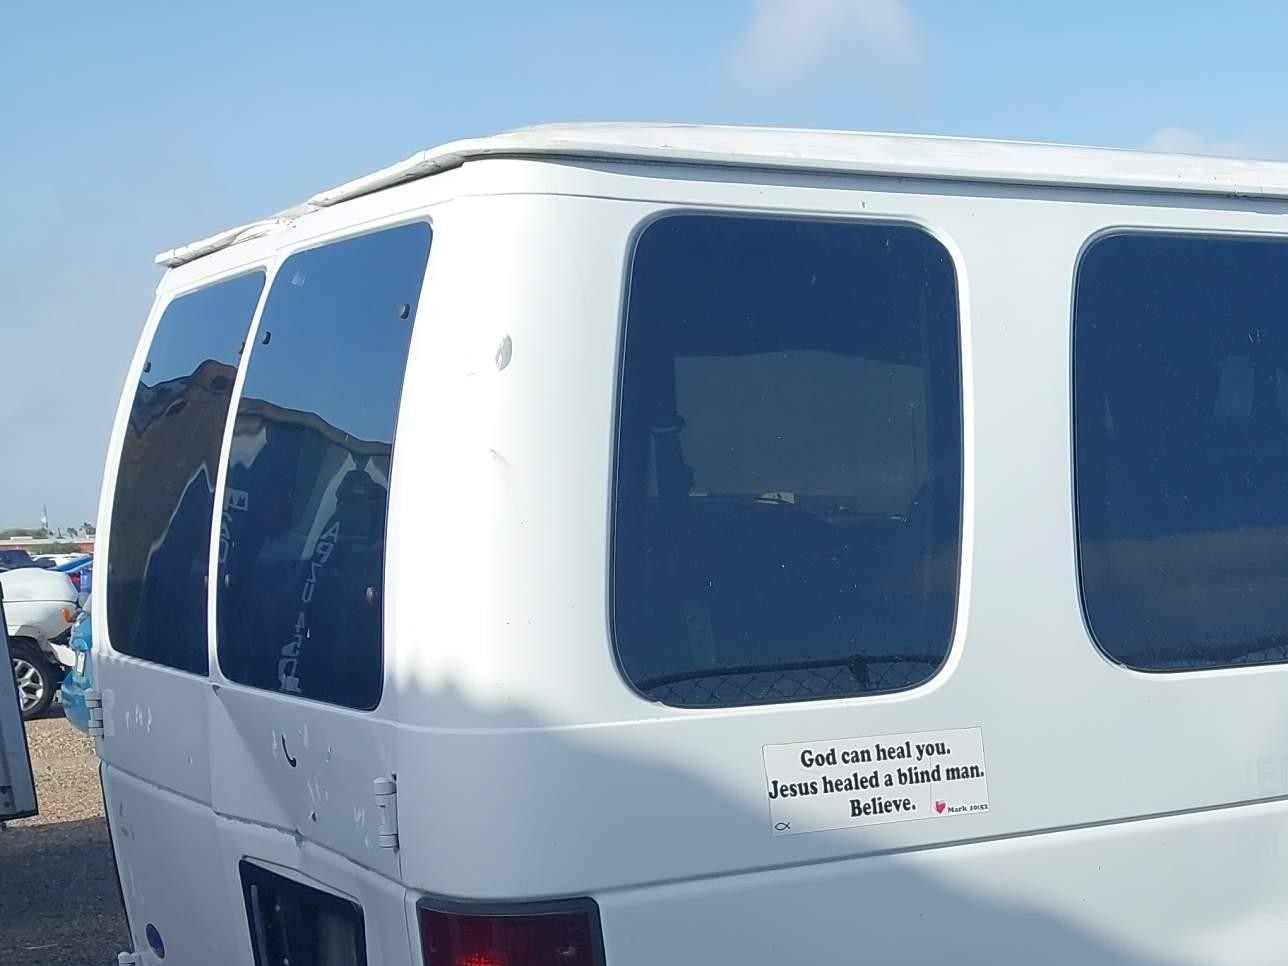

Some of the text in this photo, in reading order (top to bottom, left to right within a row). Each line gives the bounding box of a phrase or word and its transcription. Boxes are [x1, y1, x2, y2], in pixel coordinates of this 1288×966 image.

[800, 741, 951, 768] God can heal you.
[769, 764, 985, 799] Jesus healed a blind man.
[850, 796, 916, 818] Believe.
[947, 805, 968, 813] Mark
